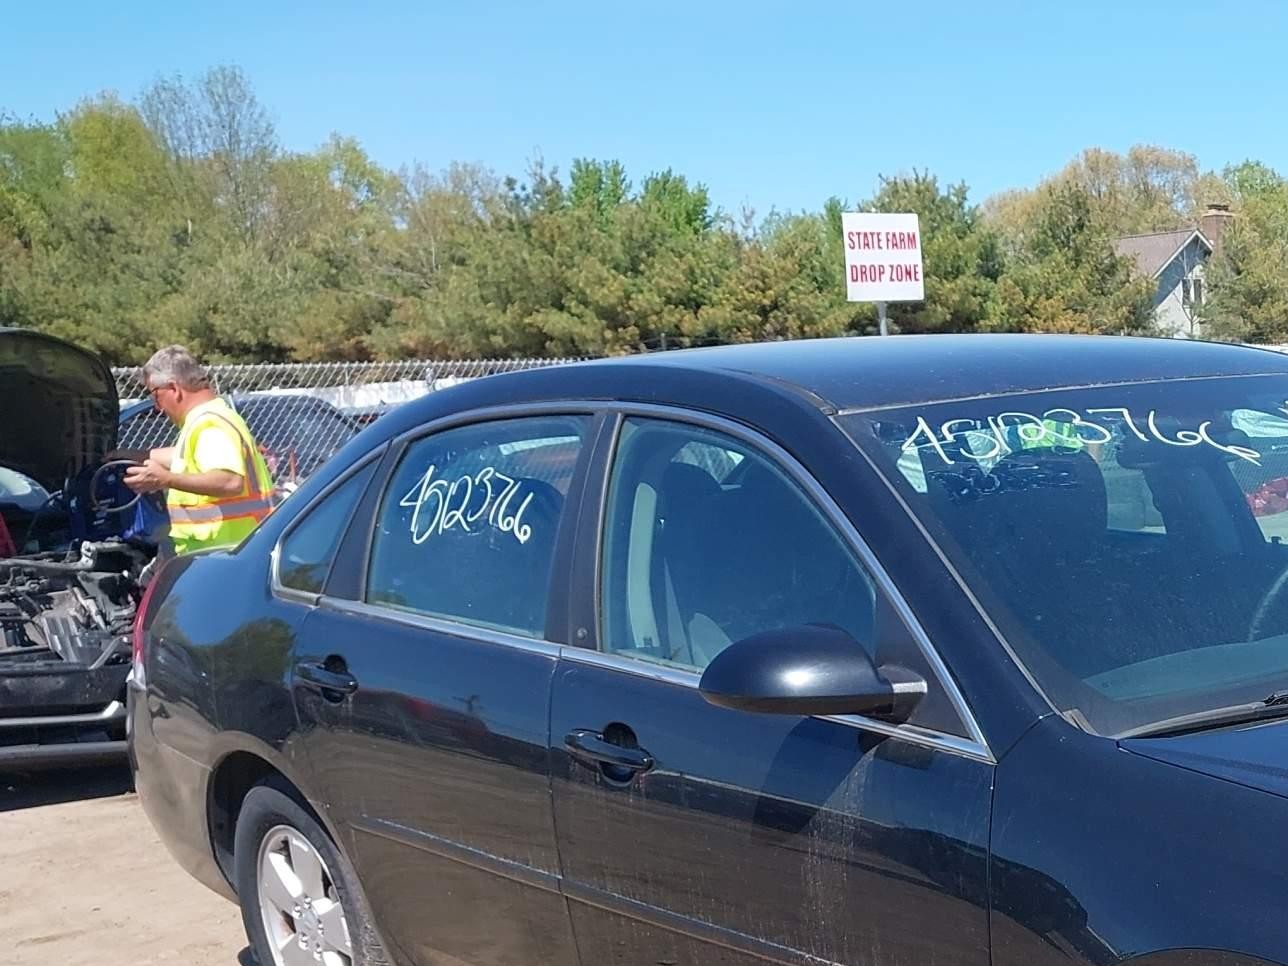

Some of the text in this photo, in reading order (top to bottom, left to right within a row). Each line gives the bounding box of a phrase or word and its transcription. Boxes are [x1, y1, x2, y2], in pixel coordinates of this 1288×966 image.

[847, 231, 917, 250] STATE FARM
[850, 263, 921, 283] DROP ZONE
[901, 408, 1262, 467] 45123766
[399, 464, 534, 545] 45123766
